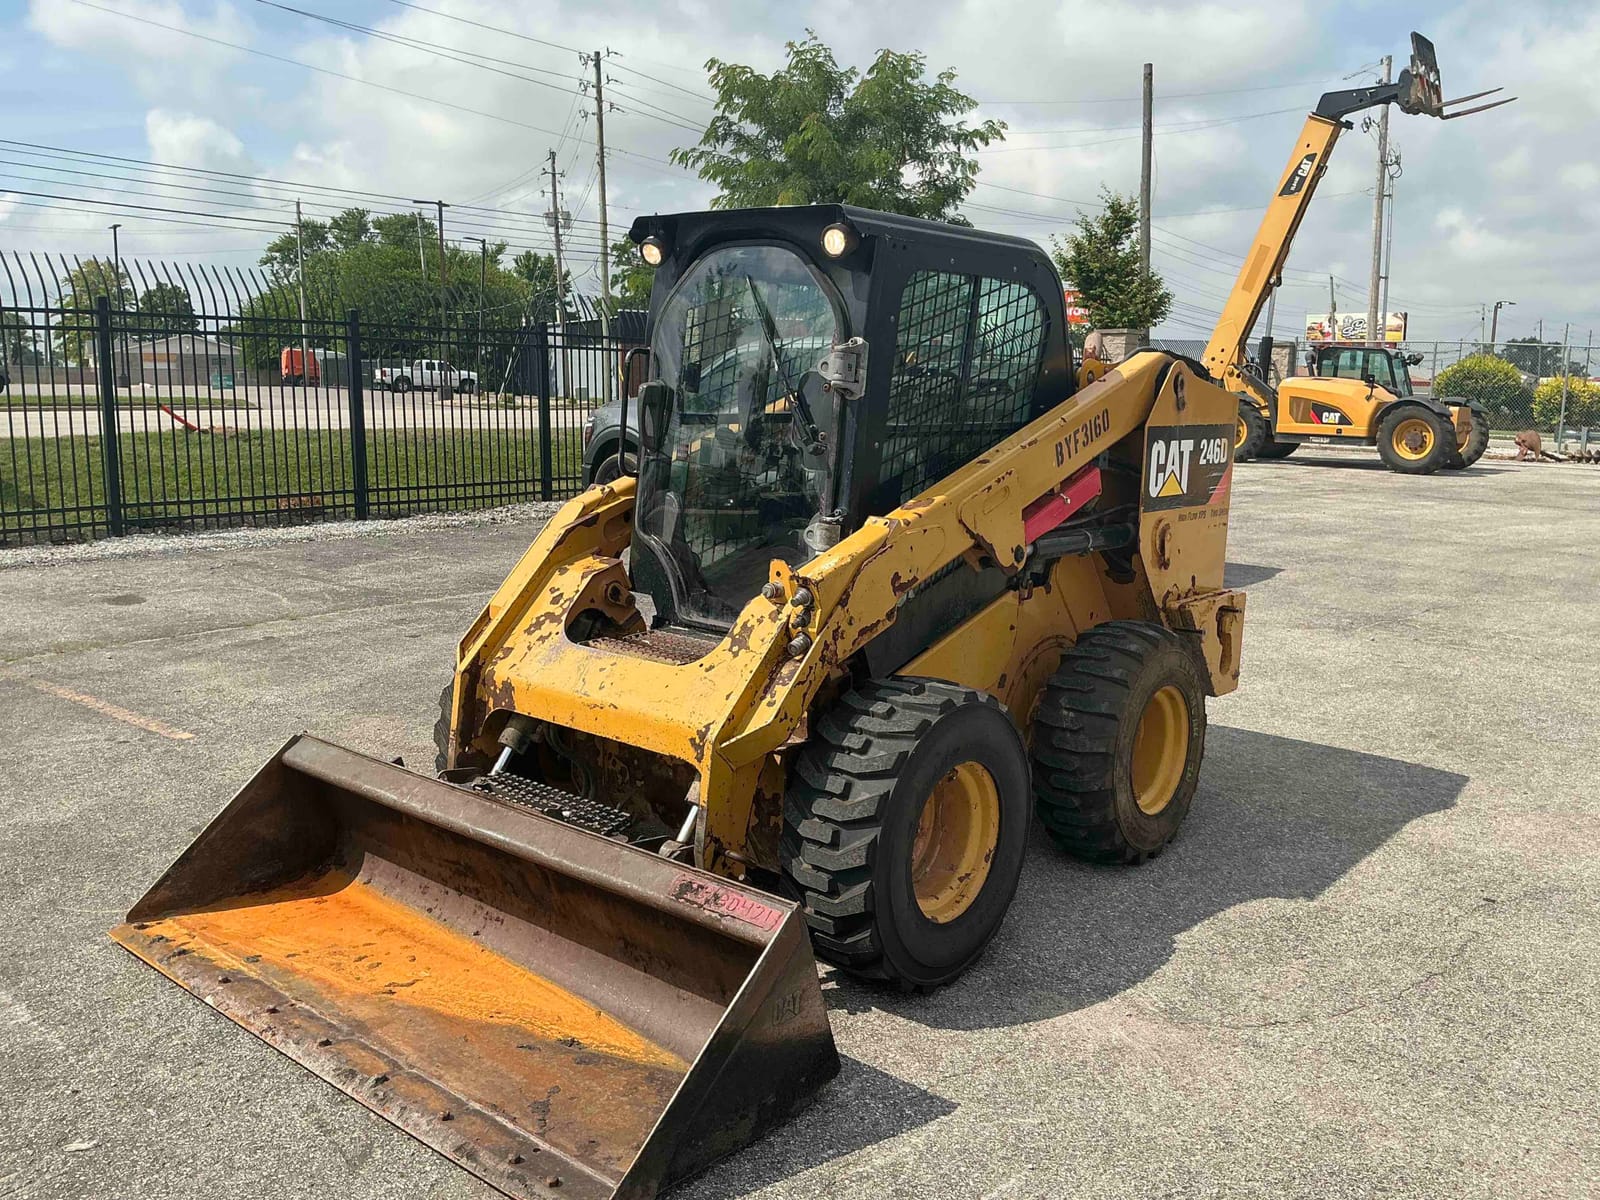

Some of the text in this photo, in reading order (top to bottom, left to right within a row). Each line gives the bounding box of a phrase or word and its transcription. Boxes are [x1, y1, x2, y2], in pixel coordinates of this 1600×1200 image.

[1298, 158, 1312, 177] CAT
[1322, 411, 1341, 424] CAT
[1055, 408, 1110, 467] BYF3160
[1148, 438, 1228, 498] CAT 246D
